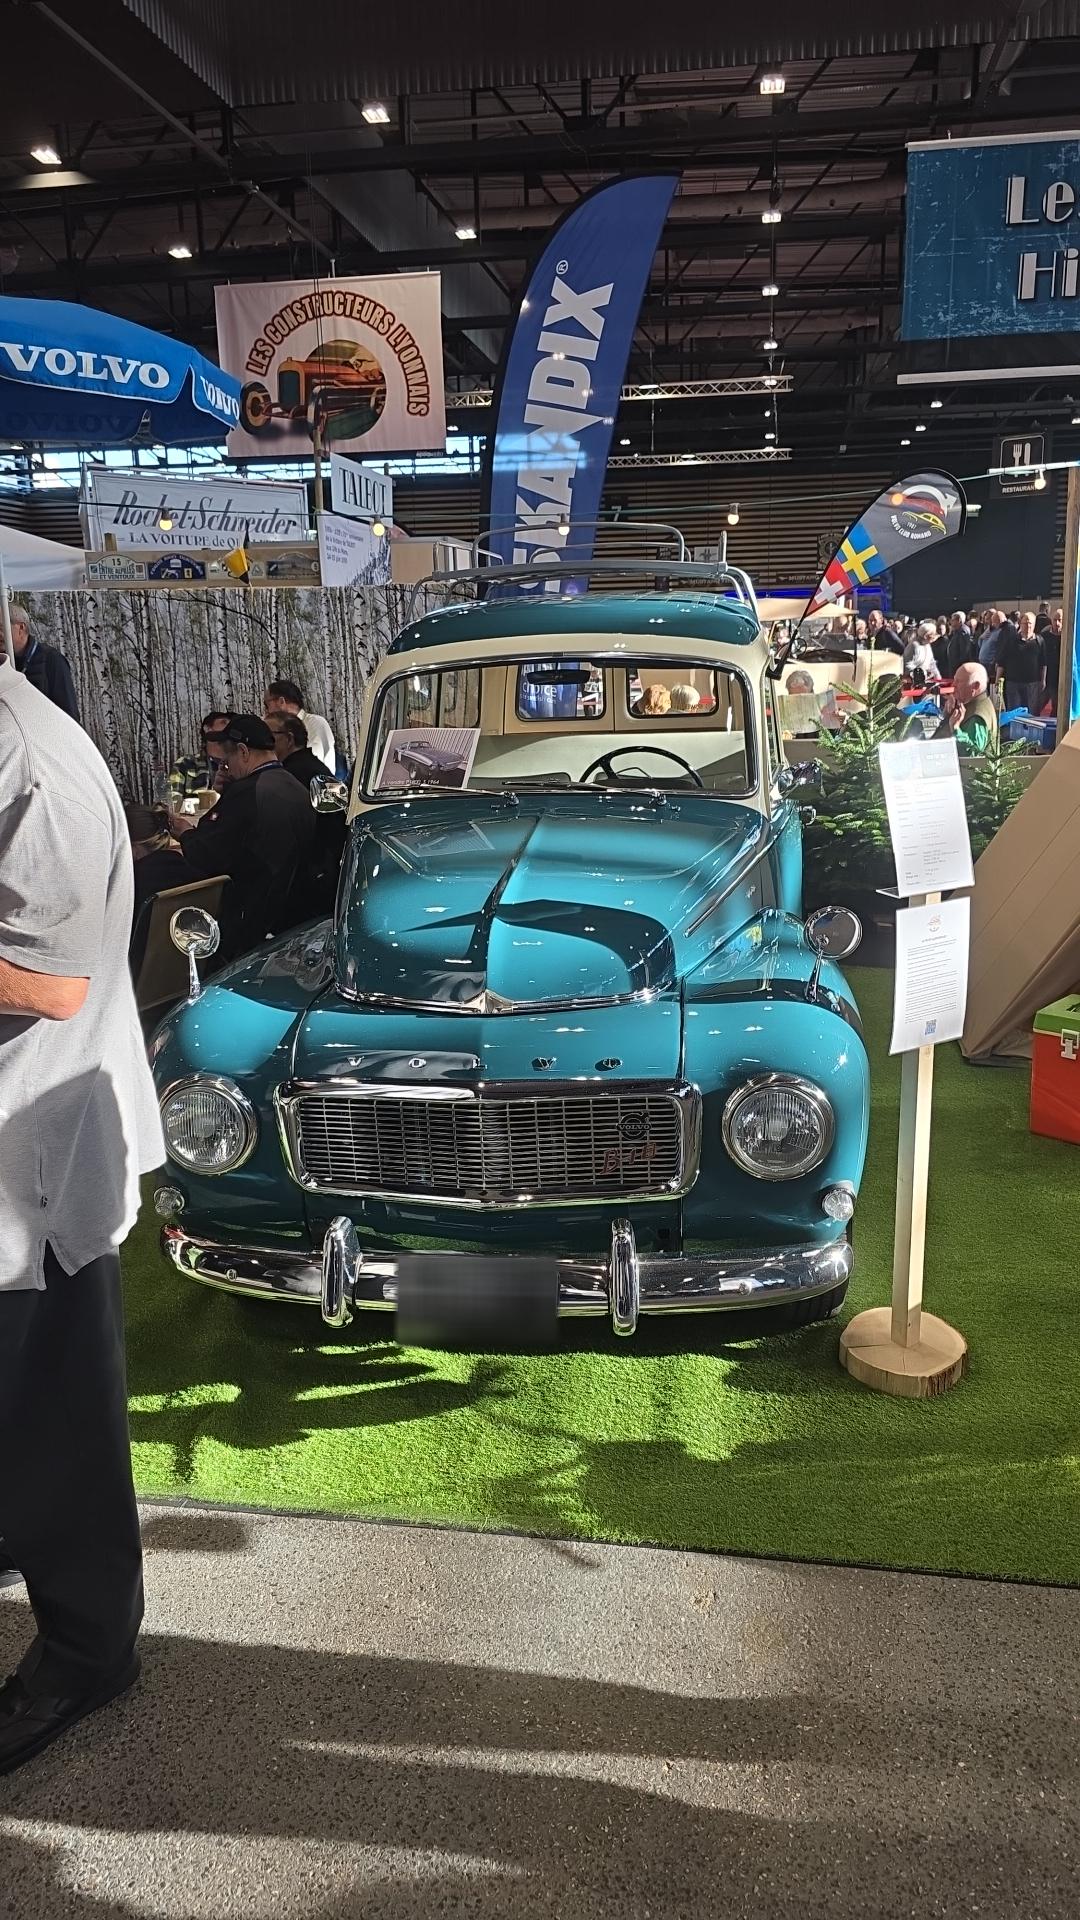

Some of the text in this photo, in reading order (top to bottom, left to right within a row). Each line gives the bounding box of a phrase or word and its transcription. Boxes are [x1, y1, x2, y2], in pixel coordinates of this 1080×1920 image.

[1006, 176, 1080, 224] Le
[0, 342, 170, 389] VOLVO
[245, 290, 430, 417] LES CONSTRUCTEURS LYONNAIS
[200, 375, 240, 420] VOLVO
[512, 276, 614, 593] SKANDIX
[339, 467, 387, 515] TALBOT
[1002, 484, 1040, 493] RESTAURAN
[129, 532, 148, 543] LA
[151, 534, 212, 546] VOITURE
[213, 536, 225, 547] de
[891, 515, 902, 531] VOLVO
[898, 528, 911, 539] CLUB
[112, 558, 121, 566] 15
